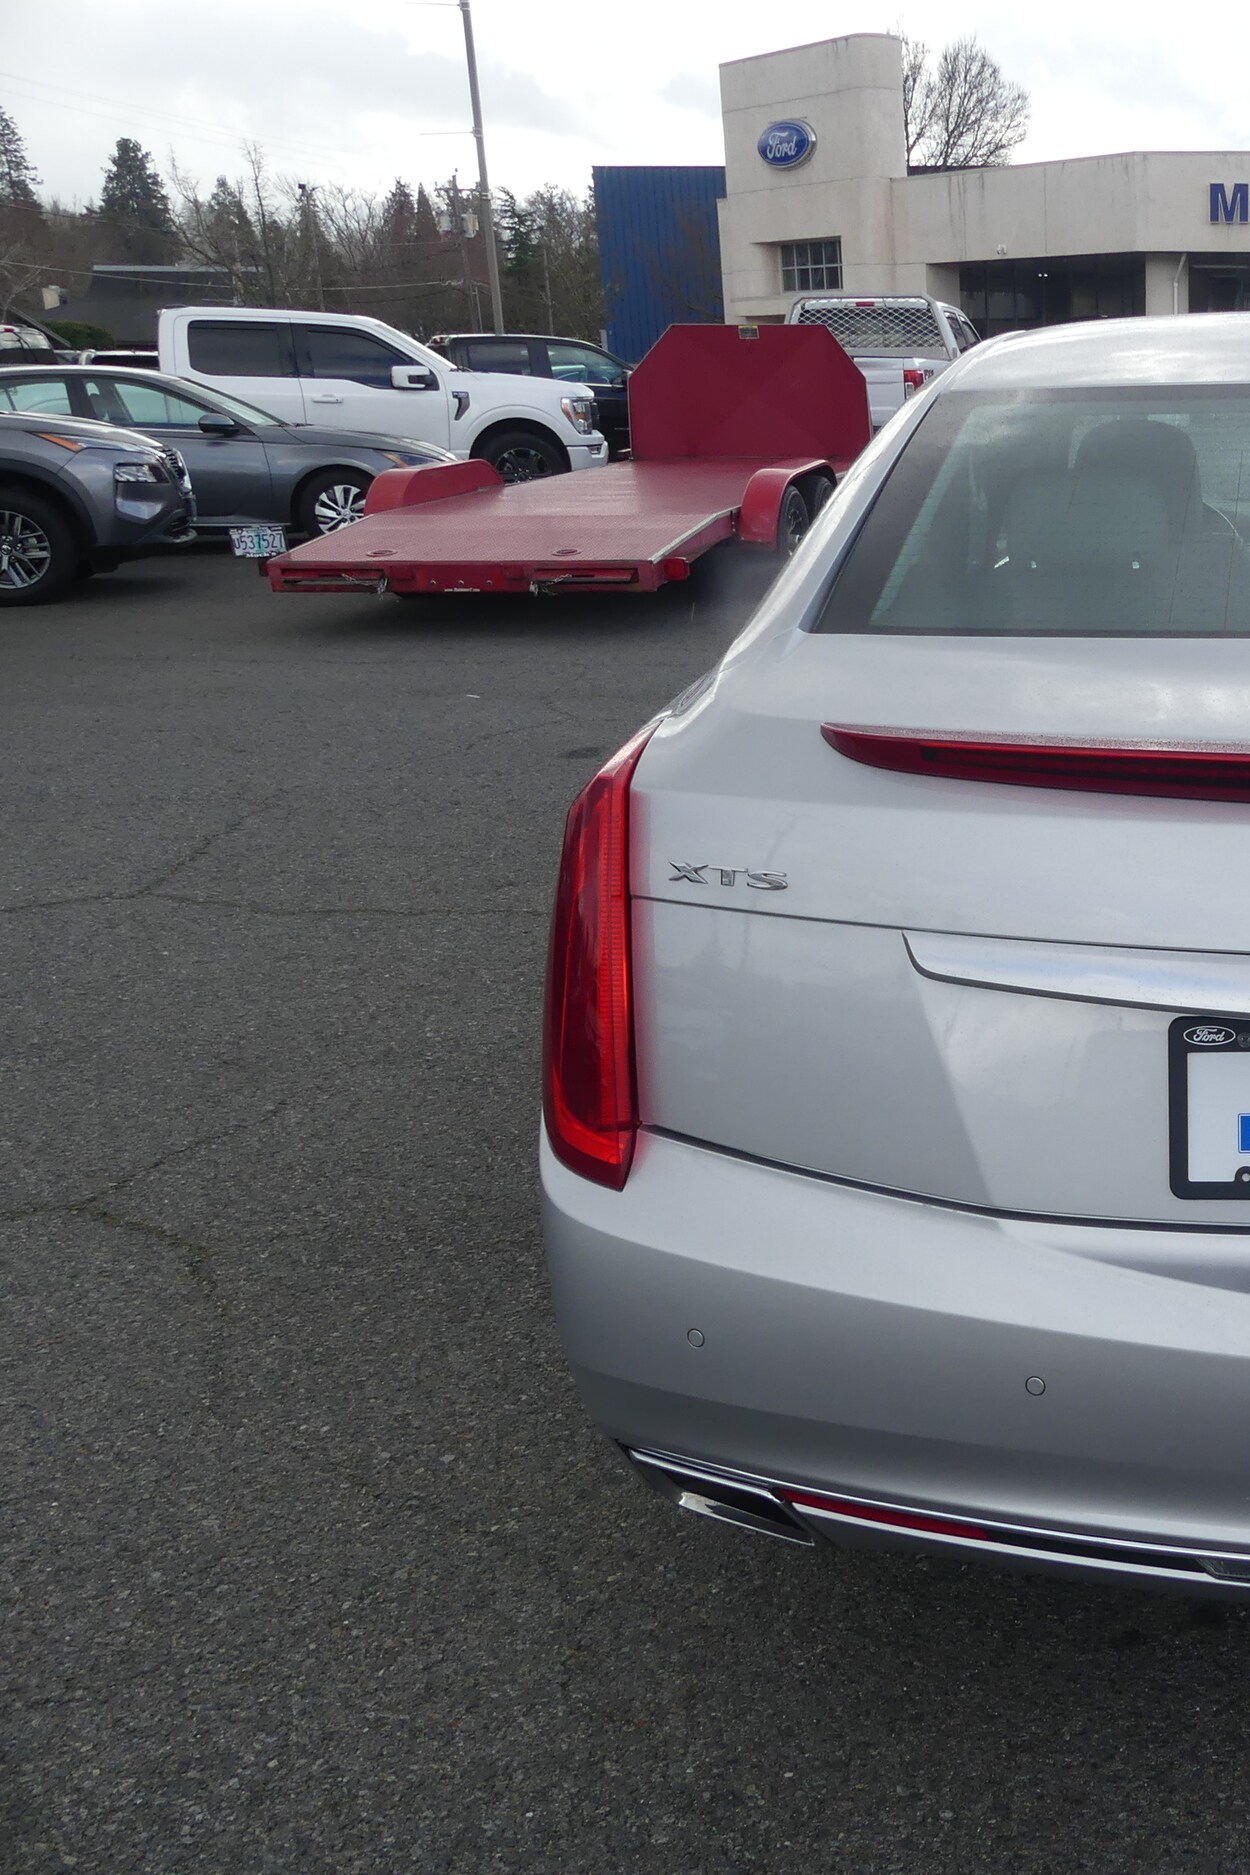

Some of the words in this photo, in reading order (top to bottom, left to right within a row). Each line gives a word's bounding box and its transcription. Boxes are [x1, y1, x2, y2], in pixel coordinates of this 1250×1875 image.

[766, 131, 798, 160] Ford
[668, 861, 789, 891] XTS
[1192, 1028, 1226, 1042] Ford
